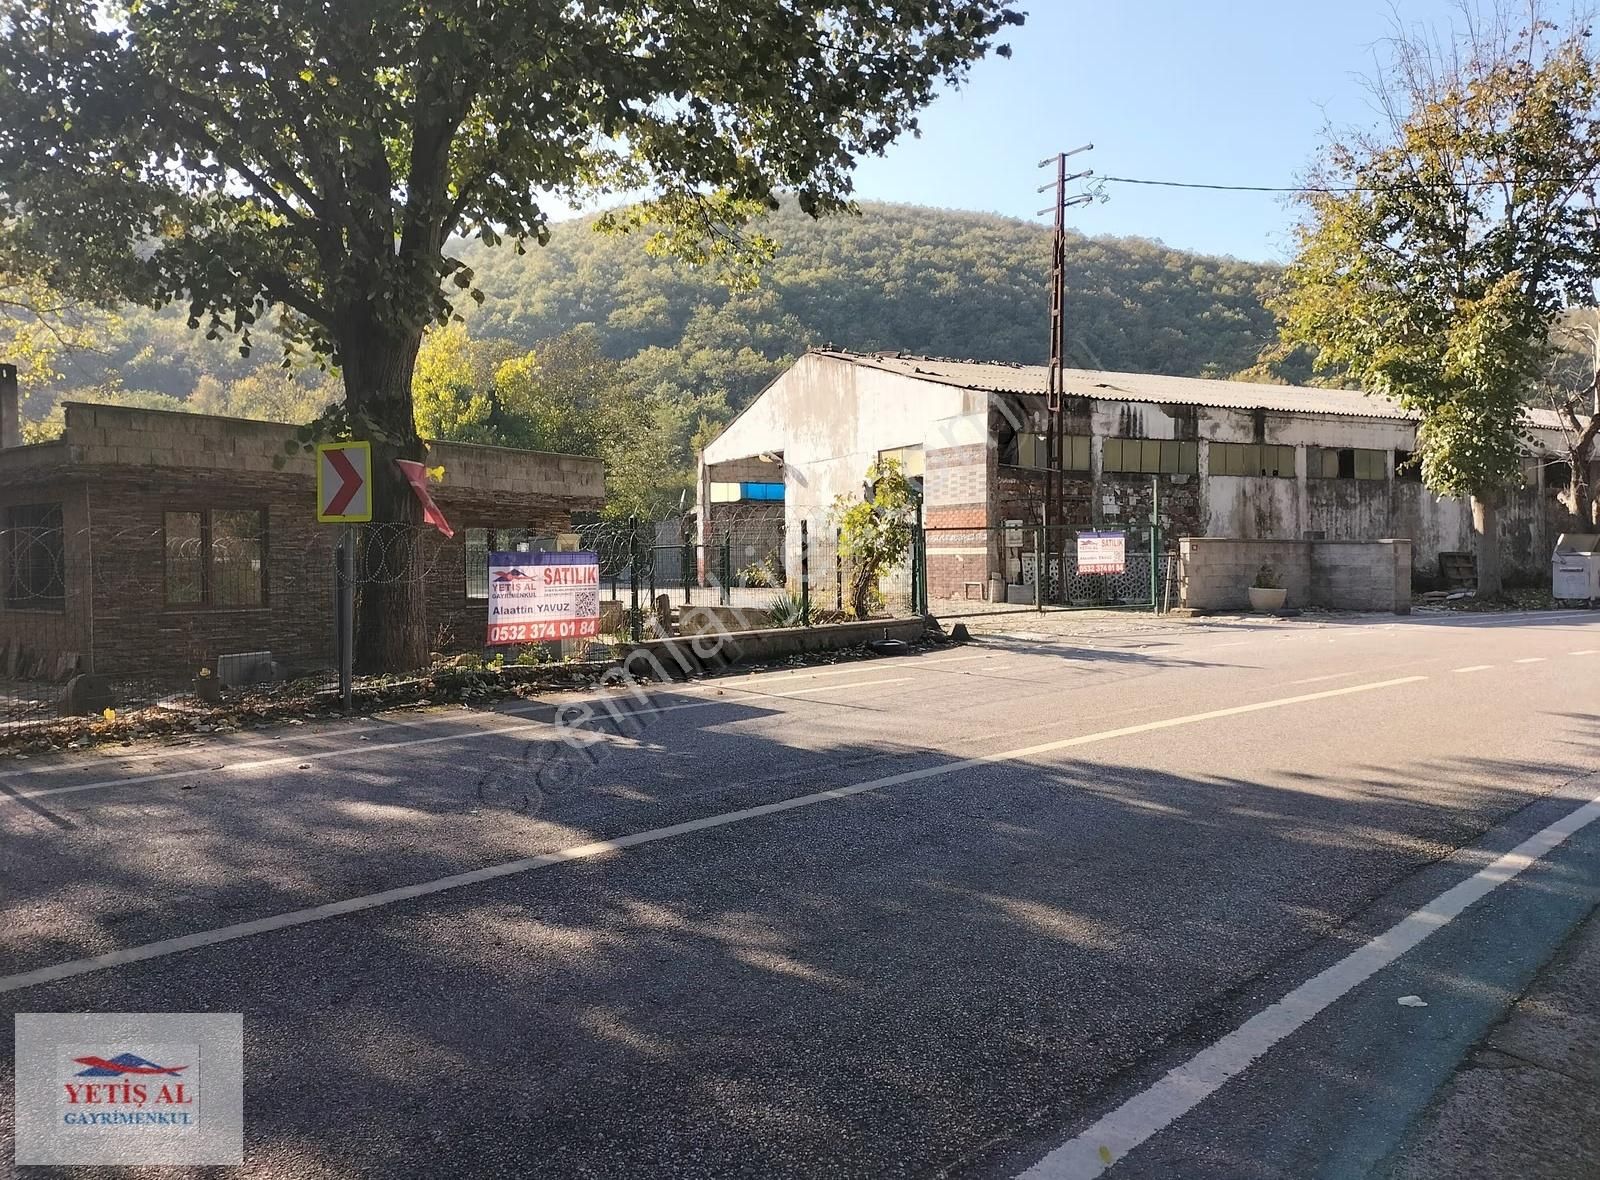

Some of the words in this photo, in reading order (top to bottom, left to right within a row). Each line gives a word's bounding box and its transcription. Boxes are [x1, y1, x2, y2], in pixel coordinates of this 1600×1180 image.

[1102, 539, 1124, 547] SATILIK
[544, 567, 597, 585] SATILIK
[525, 582, 537, 591] AL
[492, 606, 534, 616] Alaattin
[537, 603, 570, 613] YAVUZ
[491, 625, 526, 641] 0532
[530, 623, 556, 639] 374
[560, 621, 576, 637] 01
[580, 620, 595, 635] 84
